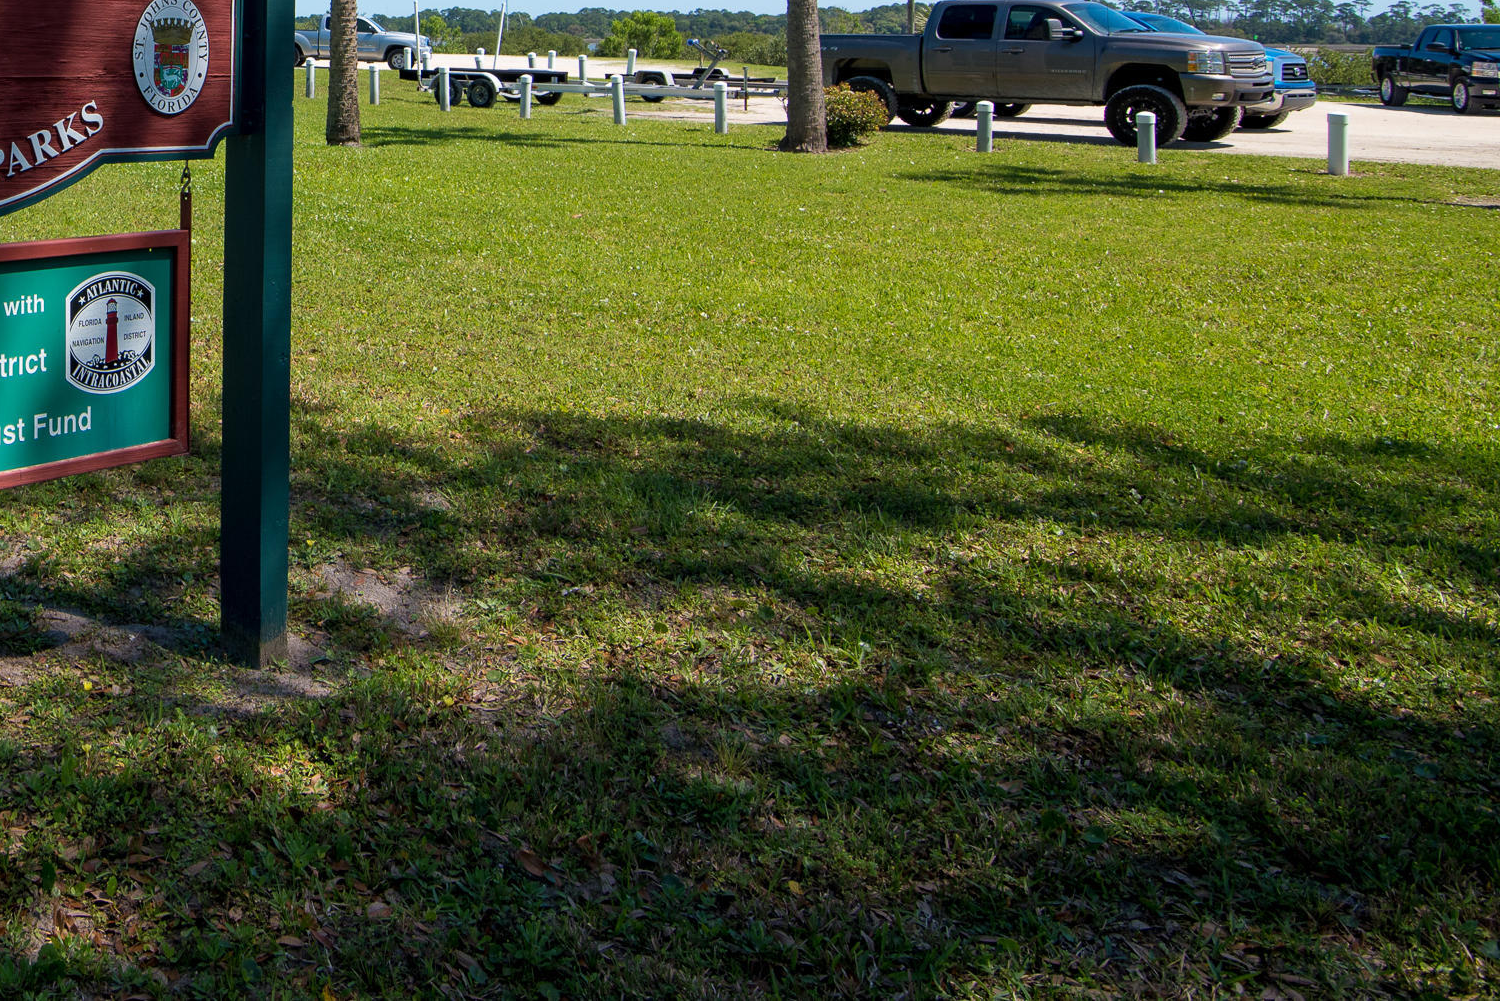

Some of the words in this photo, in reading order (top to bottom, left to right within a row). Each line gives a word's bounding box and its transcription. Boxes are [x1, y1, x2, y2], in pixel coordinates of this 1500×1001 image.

[183, 0, 208, 62] COUNTY
[143, 86, 198, 112] FLORIDA
[85, 278, 138, 301] ATLANTIC
[3, 294, 45, 317] with
[78, 318, 102, 327] FLORIDA
[124, 312, 144, 321] INLAND
[72, 337, 105, 347] NAVIGATION
[123, 330, 146, 341] DISTRICT
[71, 356, 151, 389] INTRACOASTAL
[33, 406, 92, 440] Fund
